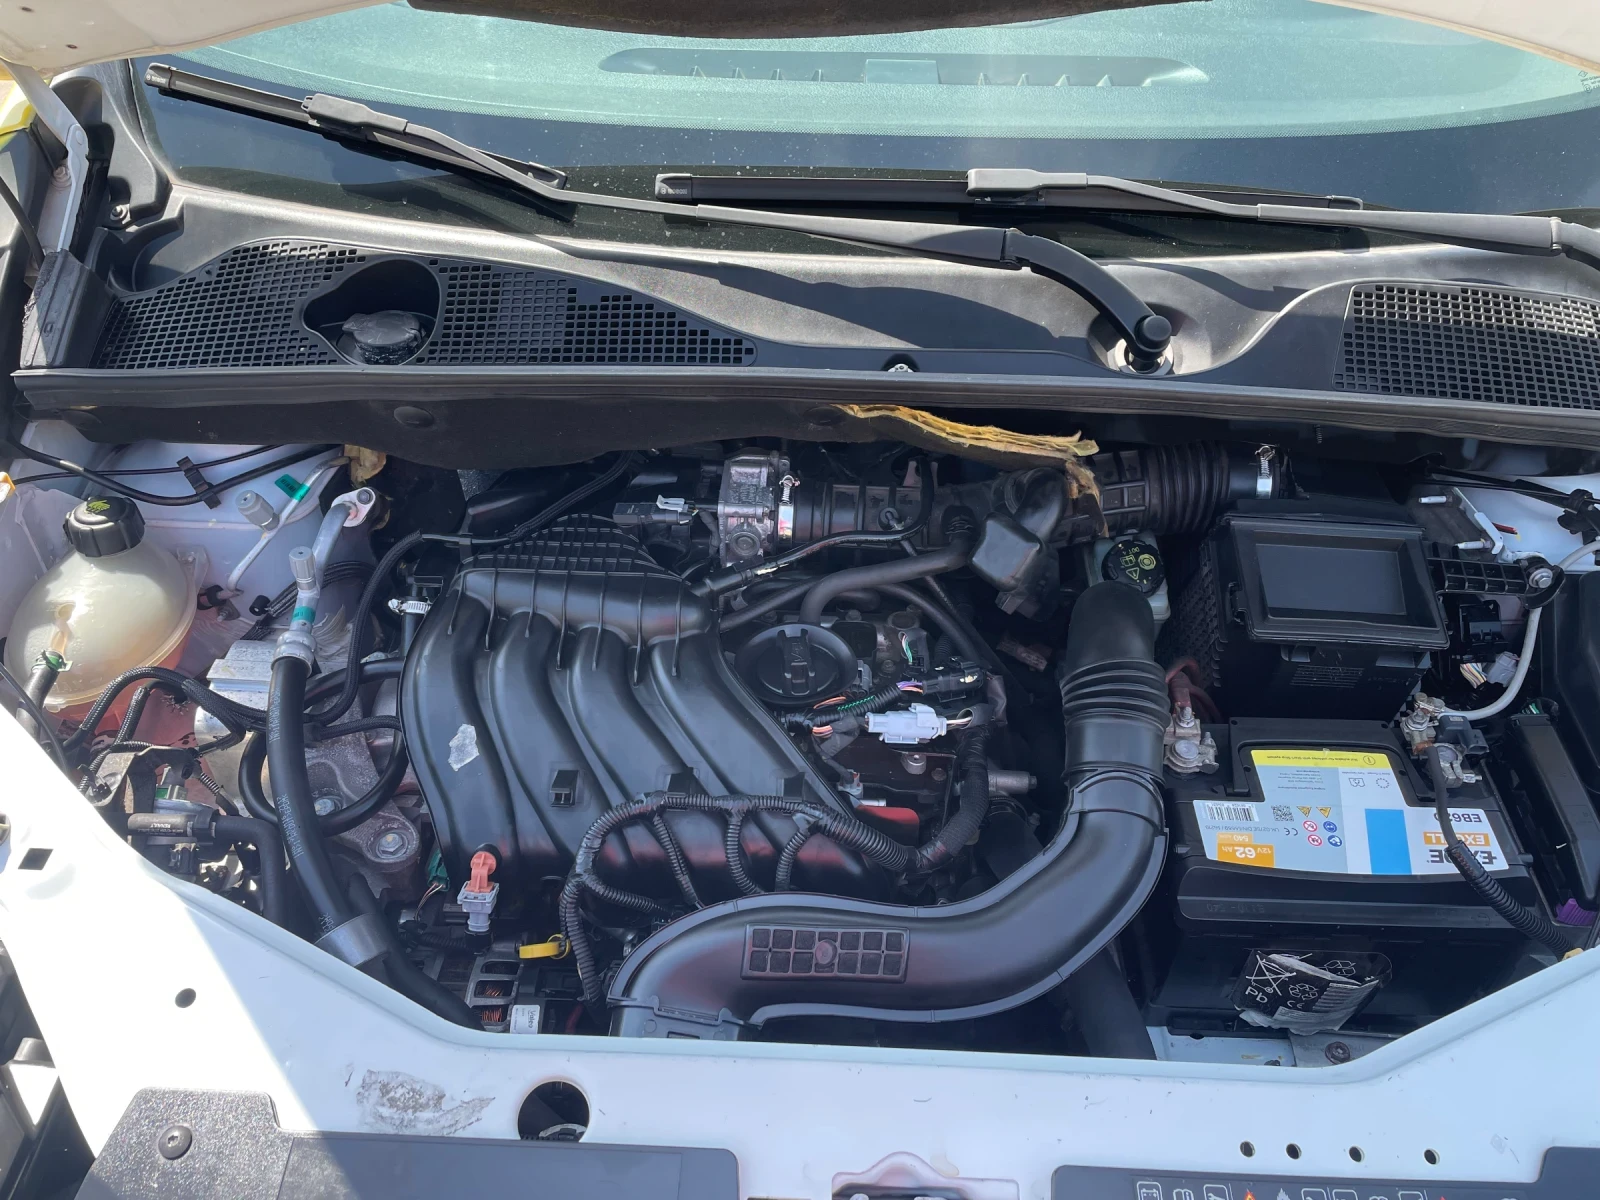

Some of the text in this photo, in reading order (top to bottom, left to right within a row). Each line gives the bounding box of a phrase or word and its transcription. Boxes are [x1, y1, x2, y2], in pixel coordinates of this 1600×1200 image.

[1233, 834, 1249, 842] 540
[1426, 833, 1485, 845] EXCLL
[1221, 845, 1233, 853] Ah
[1234, 846, 1256, 859] 62
[1245, 986, 1268, 1004] Pb
